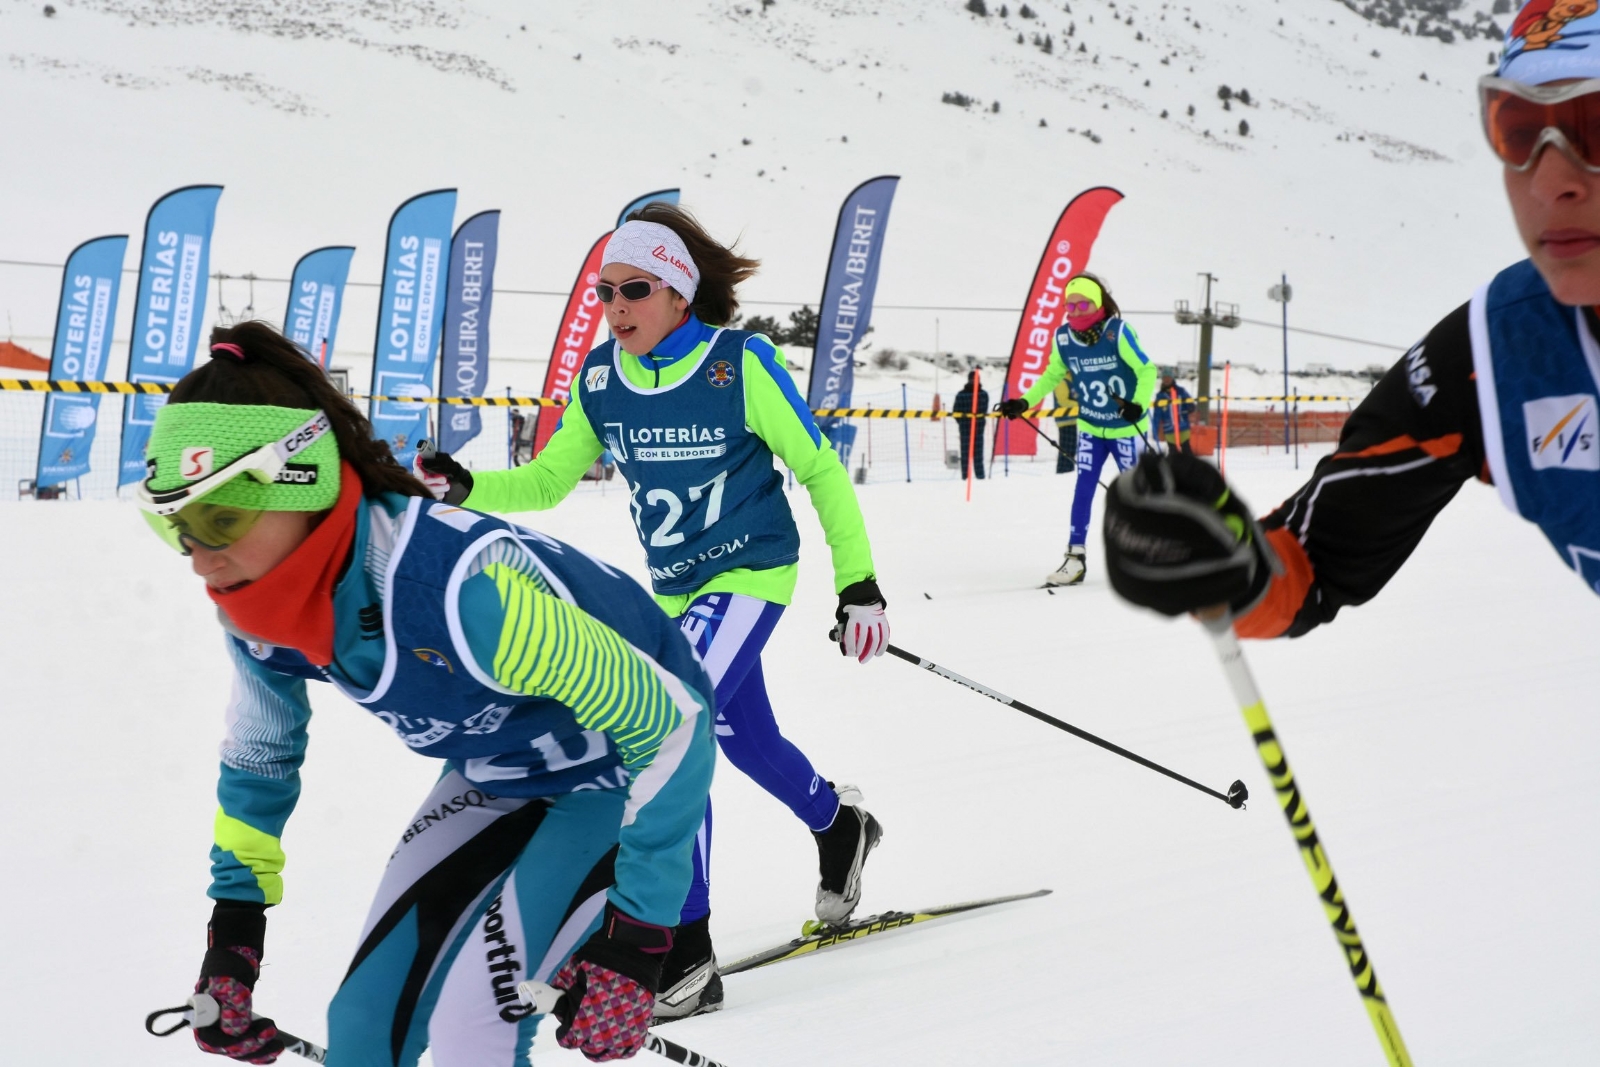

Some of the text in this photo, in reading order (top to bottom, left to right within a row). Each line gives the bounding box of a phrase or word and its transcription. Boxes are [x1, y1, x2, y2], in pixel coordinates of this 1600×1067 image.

[63, 274, 93, 380] OTERÍAS
[143, 230, 179, 364] LOTERÍAS
[174, 249, 195, 351] CON EL DEPORTE
[388, 235, 420, 362] LOTERÍAS
[417, 251, 436, 349] CON EL DEPORTE
[630, 424, 726, 443] LOTERÍAS
[674, 449, 716, 458] DEPORTE
[1531, 433, 1594, 453] FIS
